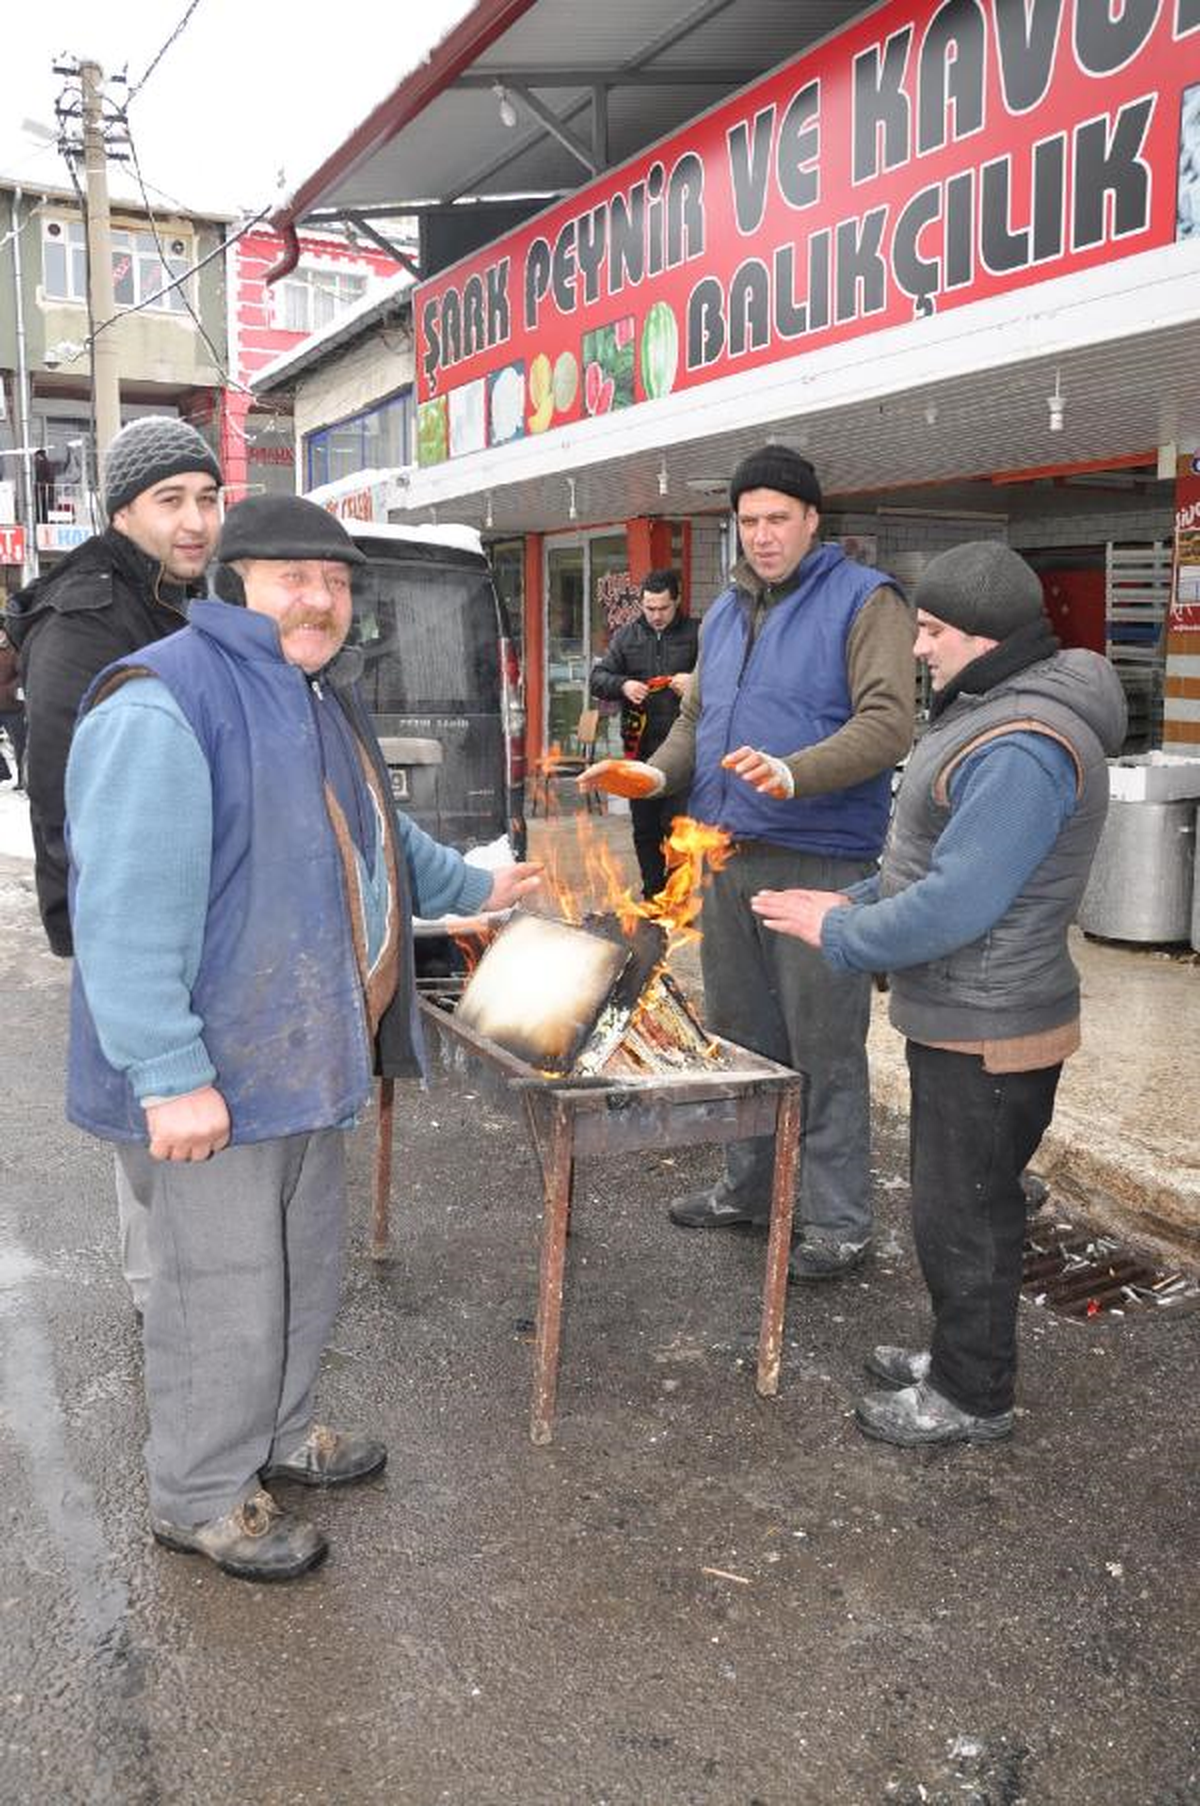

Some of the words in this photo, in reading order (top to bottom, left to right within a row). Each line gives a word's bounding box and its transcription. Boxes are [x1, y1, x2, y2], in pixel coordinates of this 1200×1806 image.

[423, 256, 510, 396] ŞARK
[524, 151, 705, 332] PEYNİR
[726, 78, 821, 237] VE
[687, 92, 1158, 371] BALIKÇILIK
